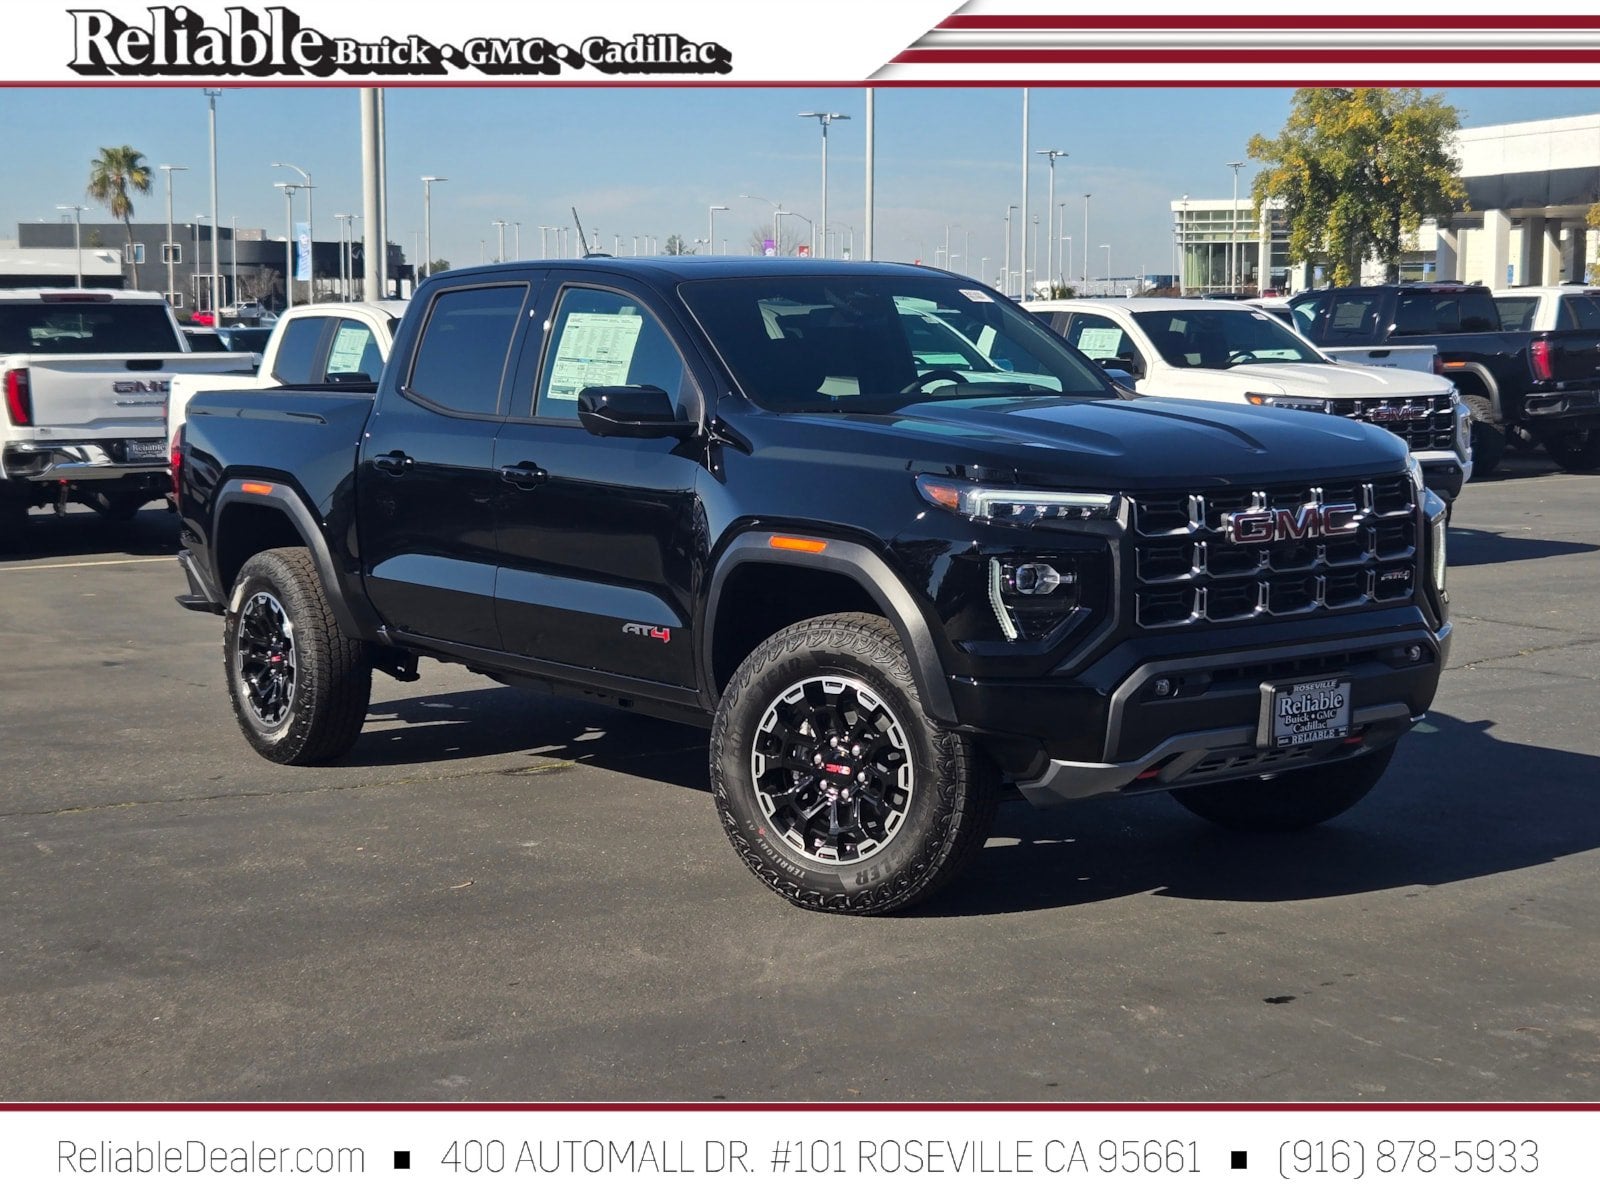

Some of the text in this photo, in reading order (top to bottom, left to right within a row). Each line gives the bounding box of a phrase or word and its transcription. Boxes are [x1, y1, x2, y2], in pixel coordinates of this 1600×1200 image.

[1371, 404, 1427, 421] GMC
[1231, 503, 1357, 544] GMC
[622, 622, 671, 643] AT4
[1280, 690, 1344, 716] Reliable
[1285, 709, 1337, 725] Buick GMC
[1293, 720, 1327, 733] Cadillac
[1291, 729, 1336, 745] RELIABLE
[755, 837, 806, 879] TERRITORY
